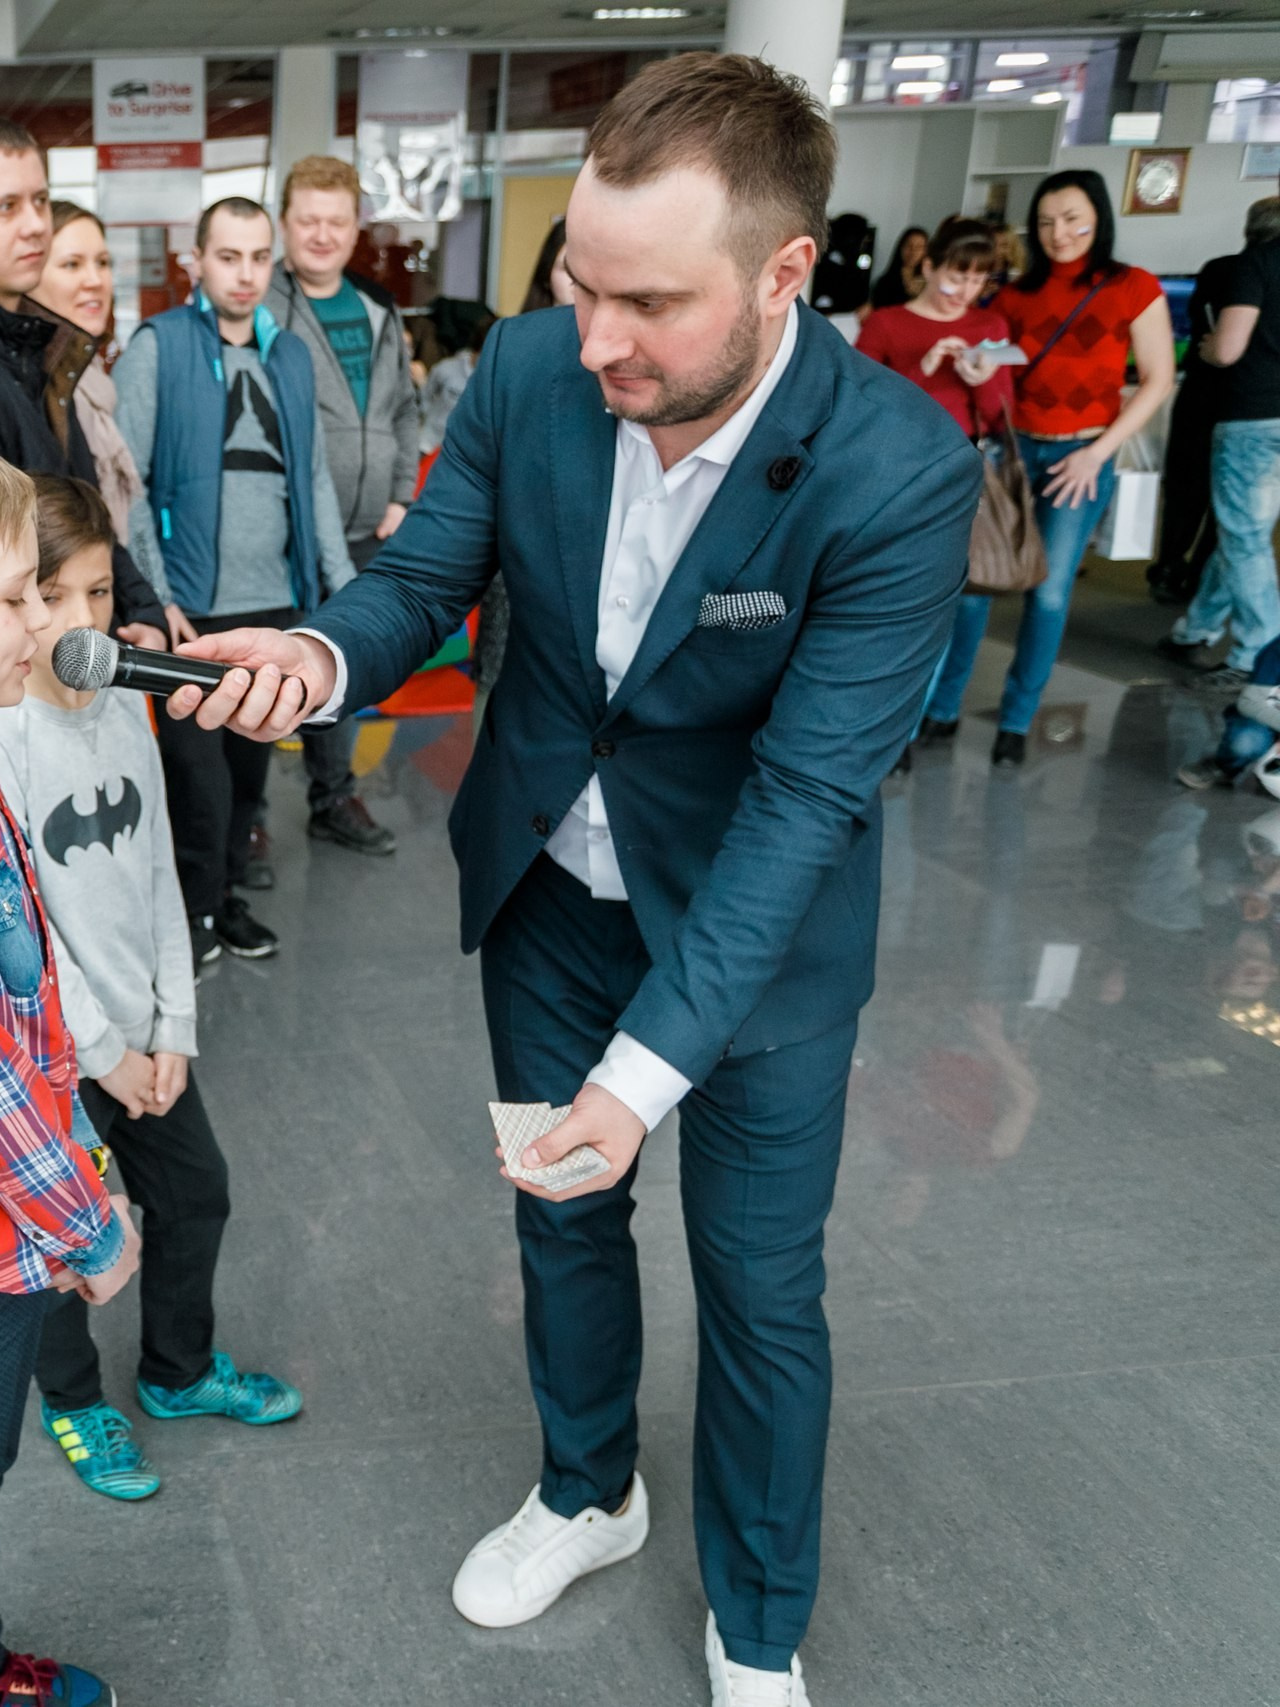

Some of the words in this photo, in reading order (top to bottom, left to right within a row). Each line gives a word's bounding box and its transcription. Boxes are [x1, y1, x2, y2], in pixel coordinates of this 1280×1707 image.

[152, 82, 193, 97] Drive
[108, 102, 124, 117] to
[129, 101, 193, 118] Surprise
